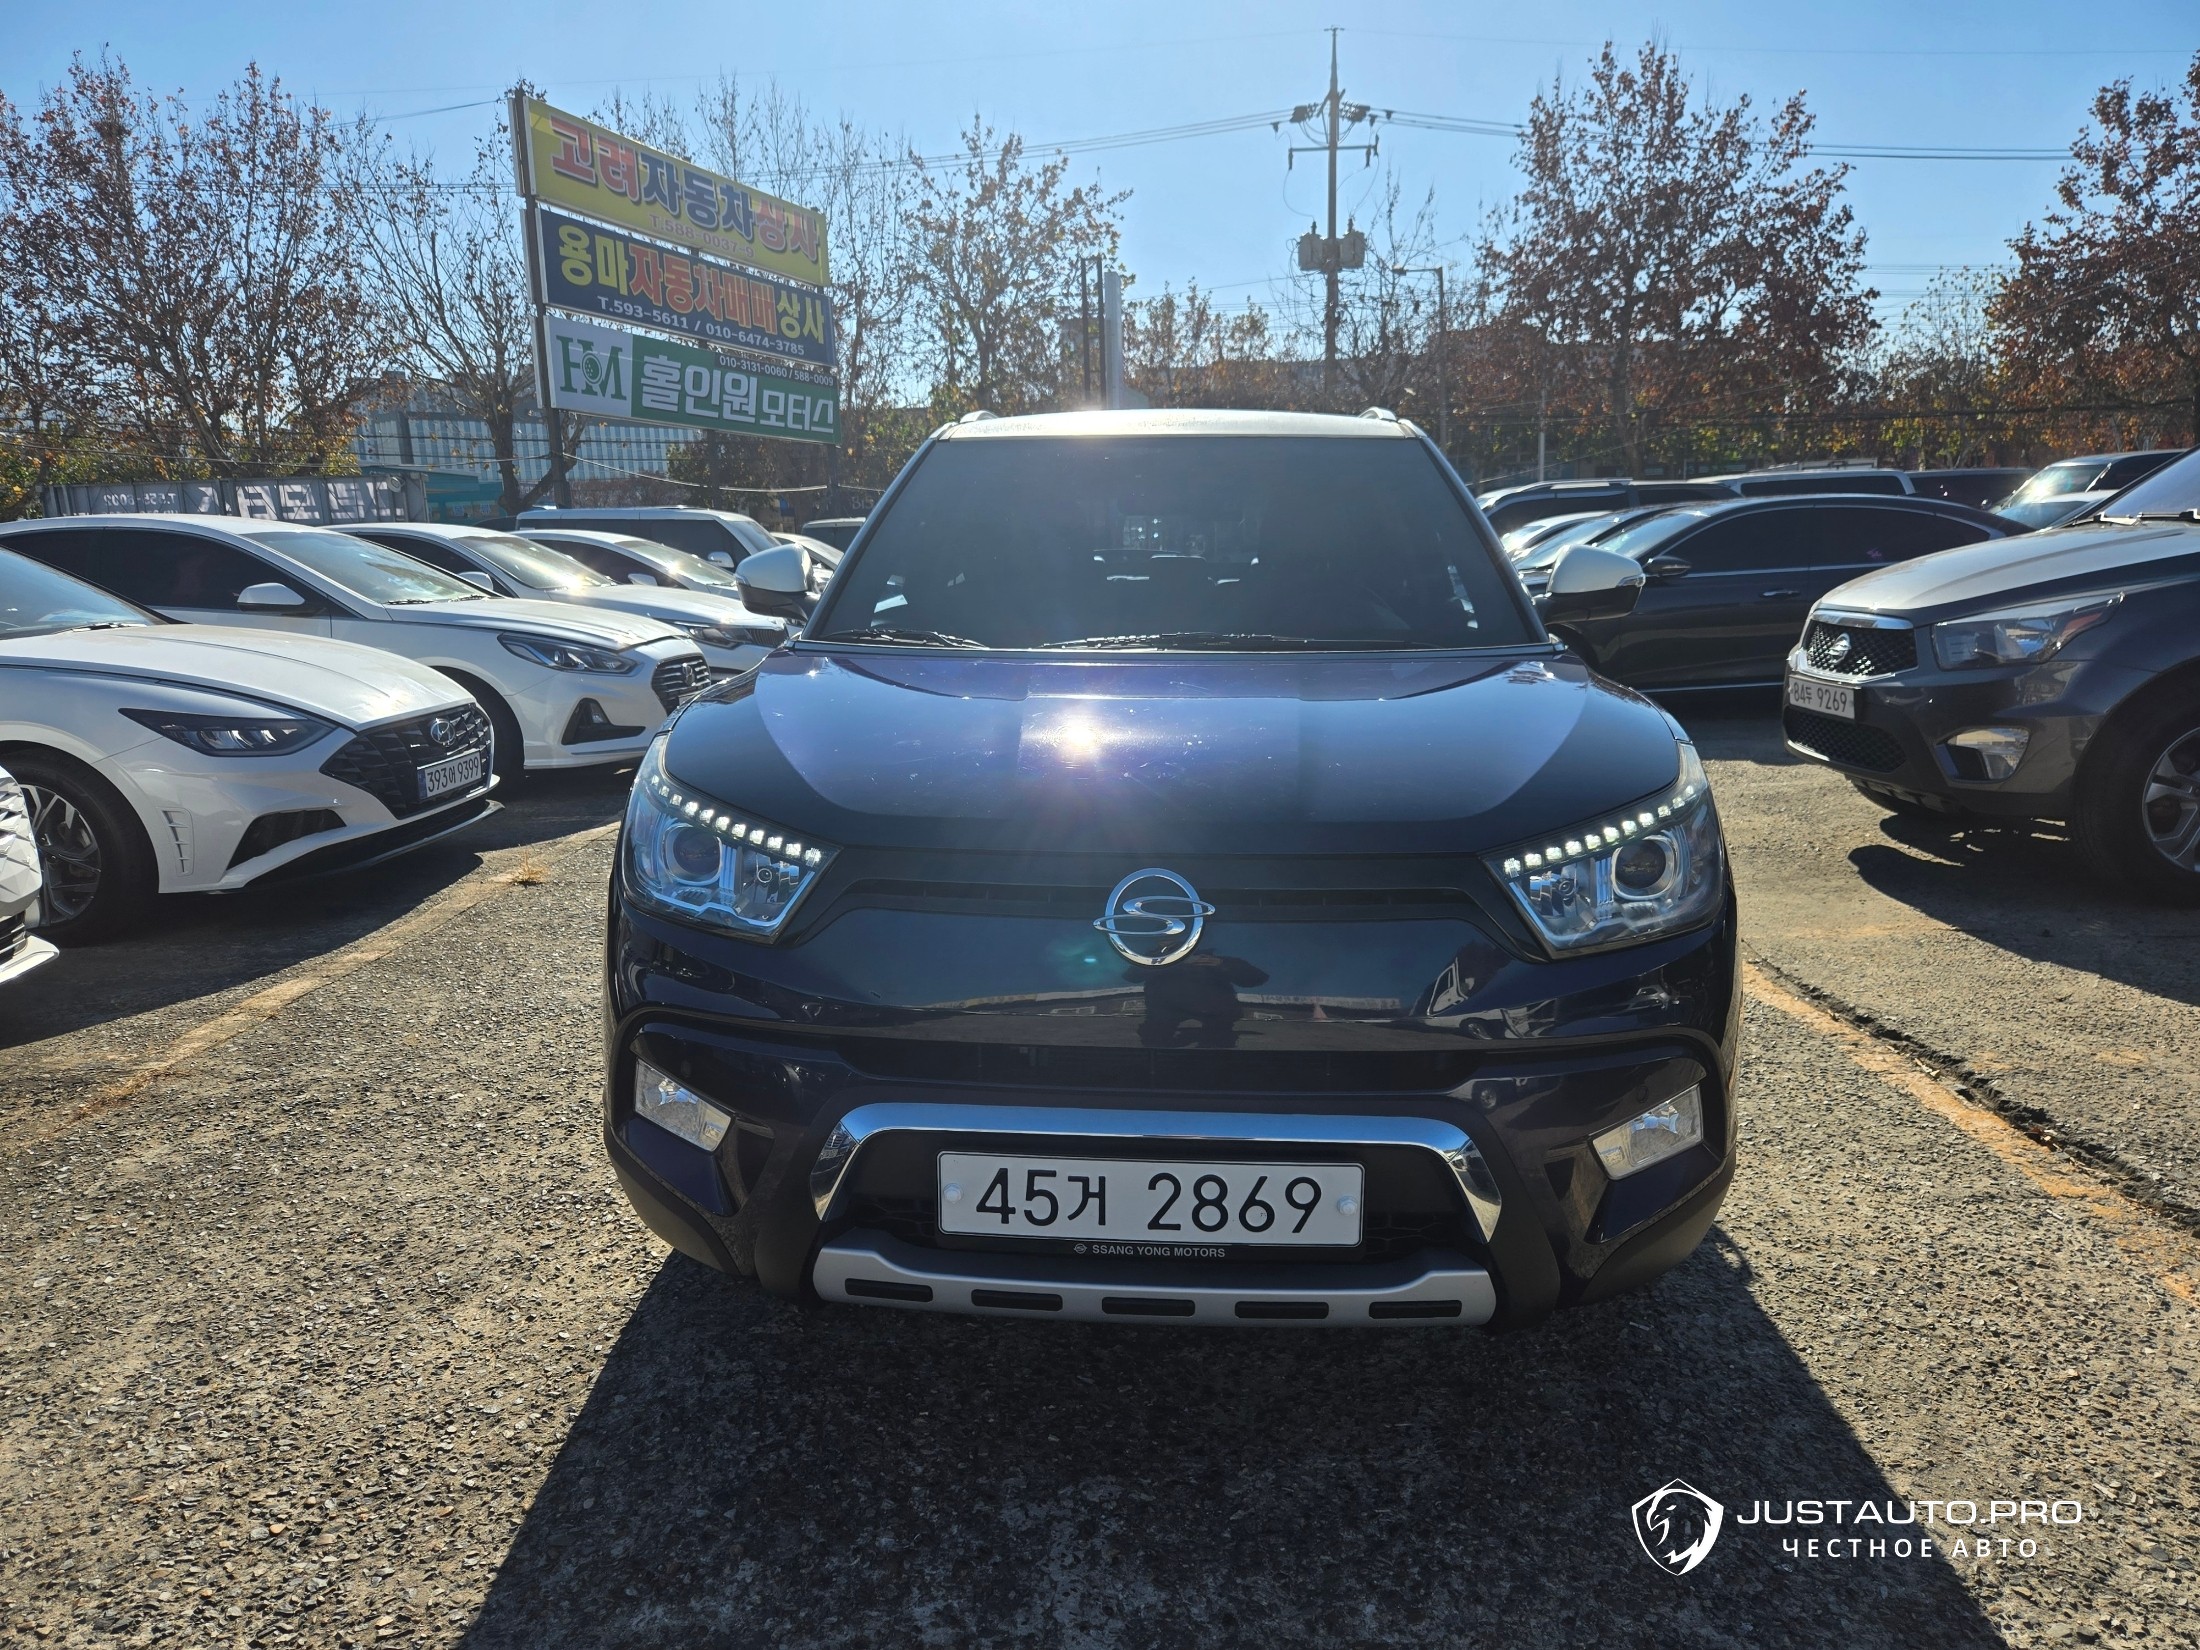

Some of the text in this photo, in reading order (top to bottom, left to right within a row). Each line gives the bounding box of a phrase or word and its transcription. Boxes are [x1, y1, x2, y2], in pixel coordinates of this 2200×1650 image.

[597, 296, 689, 330] T.593-5611
[705, 322, 806, 356] 010-6474-3785
[719, 355, 788, 378] 010-3131-0060
[794, 371, 834, 386] 588-0009
[1817, 687, 1847, 713] 9269
[457, 756, 479, 783] 9399
[976, 1167, 1322, 1234] 45거 2869
[1092, 1244, 1225, 1258] SSANG YONG MOTORS
